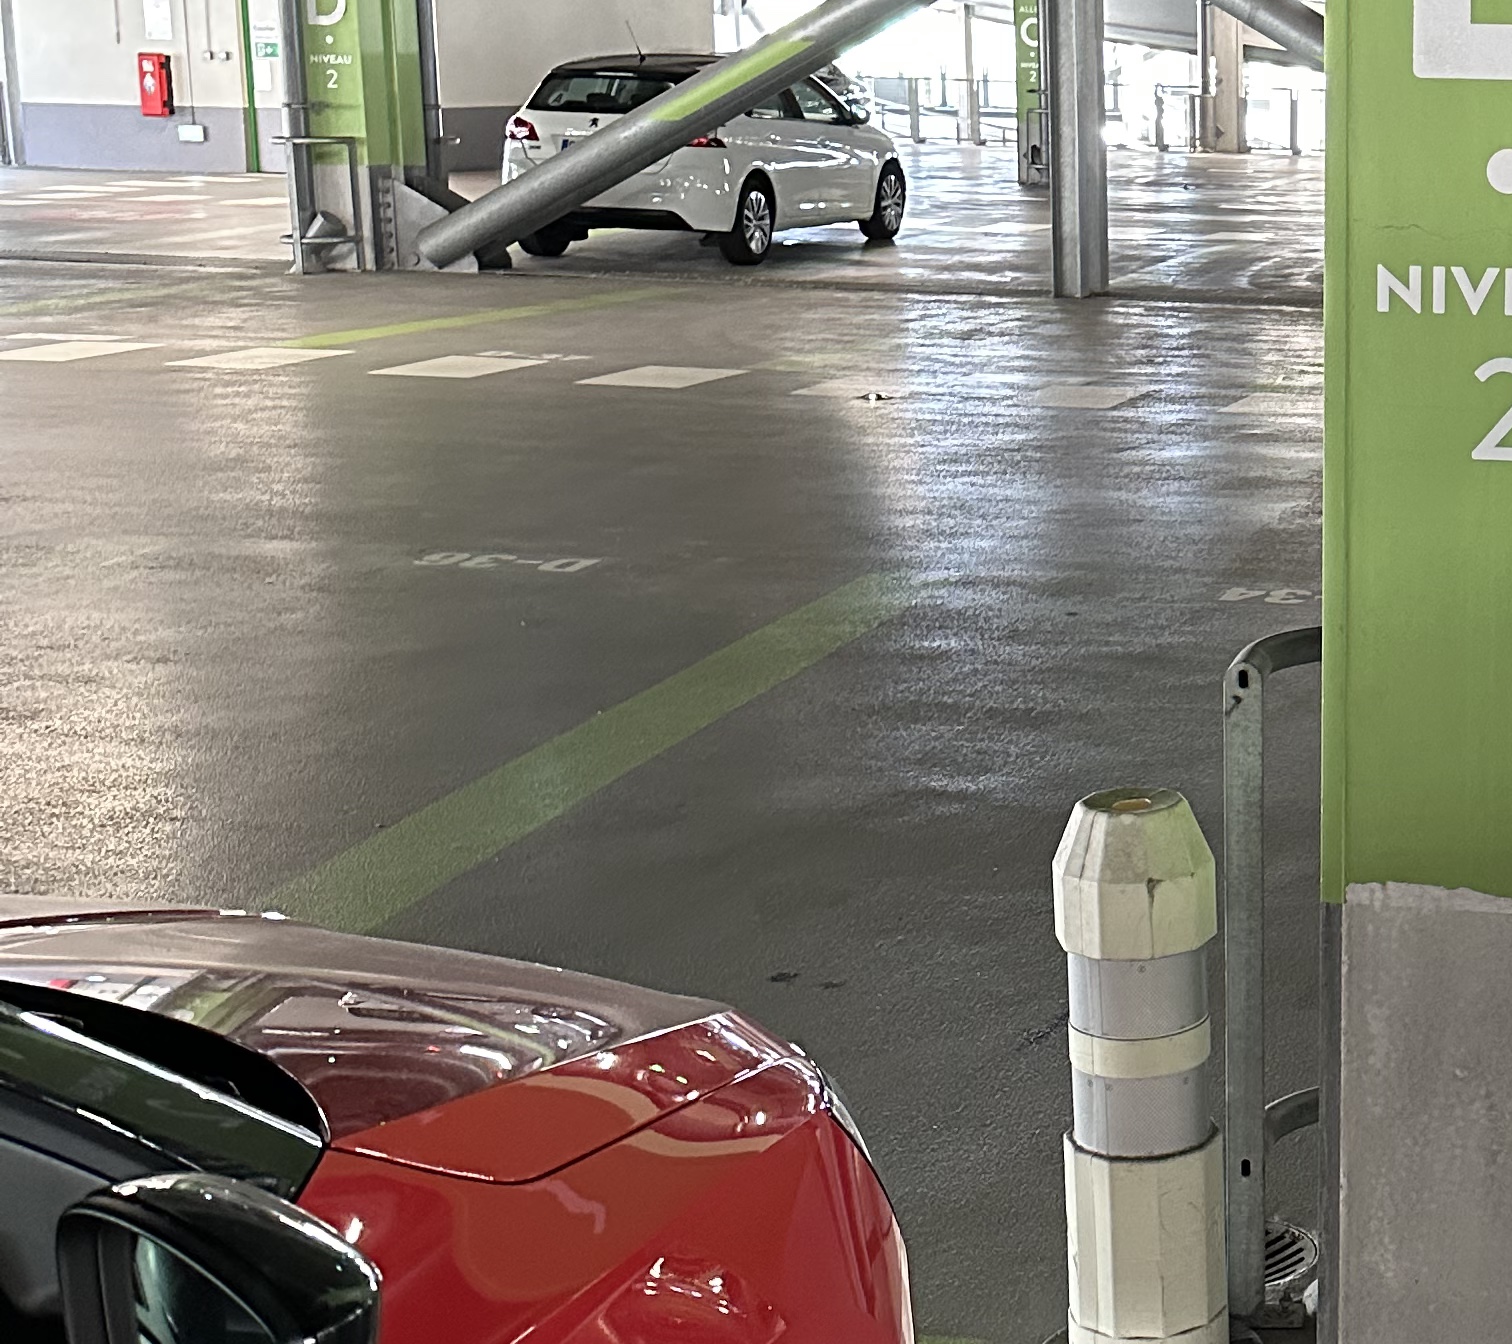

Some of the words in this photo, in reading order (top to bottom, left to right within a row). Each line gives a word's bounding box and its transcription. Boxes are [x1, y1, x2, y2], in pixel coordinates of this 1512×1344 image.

[309, 54, 352, 65] NIVEAU
[325, 69, 339, 89] 2
[1029, 70, 1038, 83] 2
